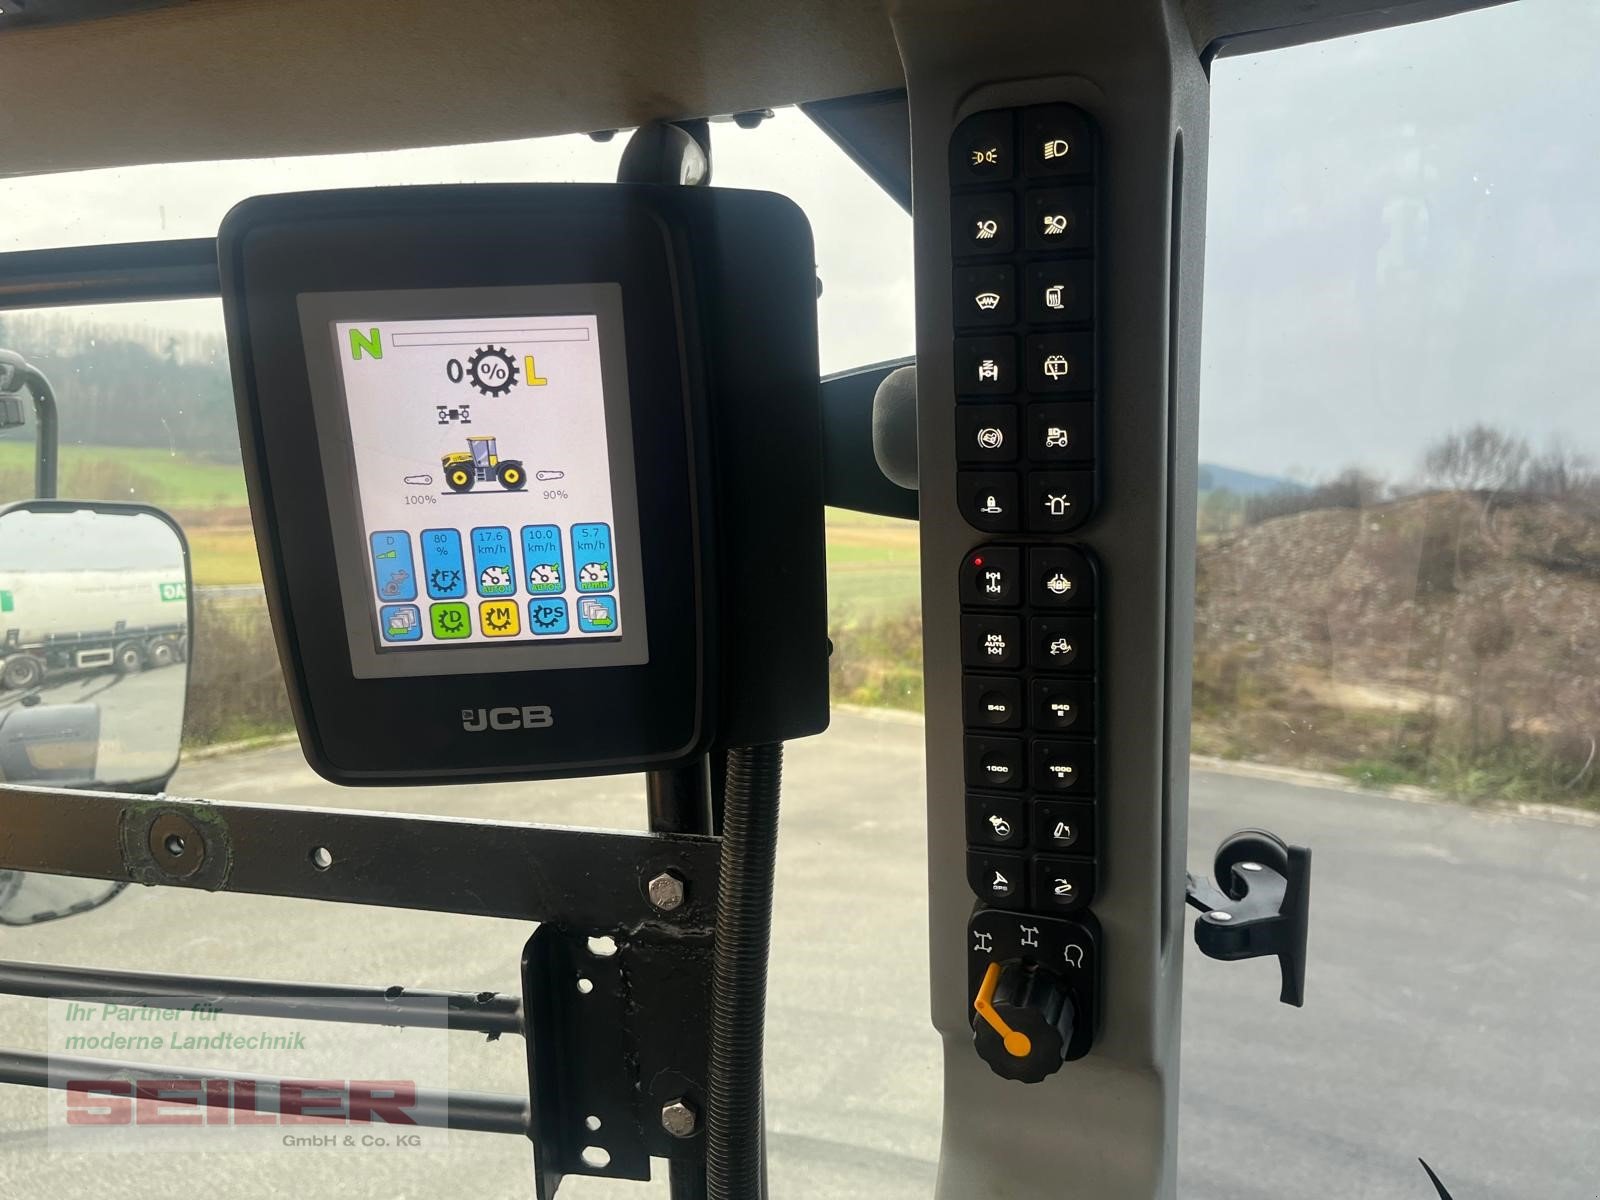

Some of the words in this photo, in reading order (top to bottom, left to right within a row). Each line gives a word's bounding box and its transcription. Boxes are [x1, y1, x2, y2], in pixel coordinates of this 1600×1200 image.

[349, 328, 383, 360] N
[446, 358, 464, 383] 0
[480, 363, 506, 379] %
[524, 355, 548, 386] L
[404, 495, 437, 505] 100%
[543, 490, 569, 500] 90%
[478, 532, 503, 542] 17.6
[529, 530, 553, 540] 10.0
[581, 528, 600, 538] 5.7
[386, 536, 395, 545] D
[434, 534, 448, 543] 80
[478, 544, 507, 555] km/h
[527, 542, 556, 553] km/h
[577, 540, 606, 551] km/h
[436, 547, 448, 556] %
[442, 570, 461, 581] FX
[450, 610, 461, 623] D
[496, 608, 510, 620] M
[543, 607, 564, 618] PS
[987, 704, 1006, 712] 540
[462, 705, 554, 732] JCB
[986, 765, 1009, 773] 1000
[1049, 765, 1072, 773] 1000
